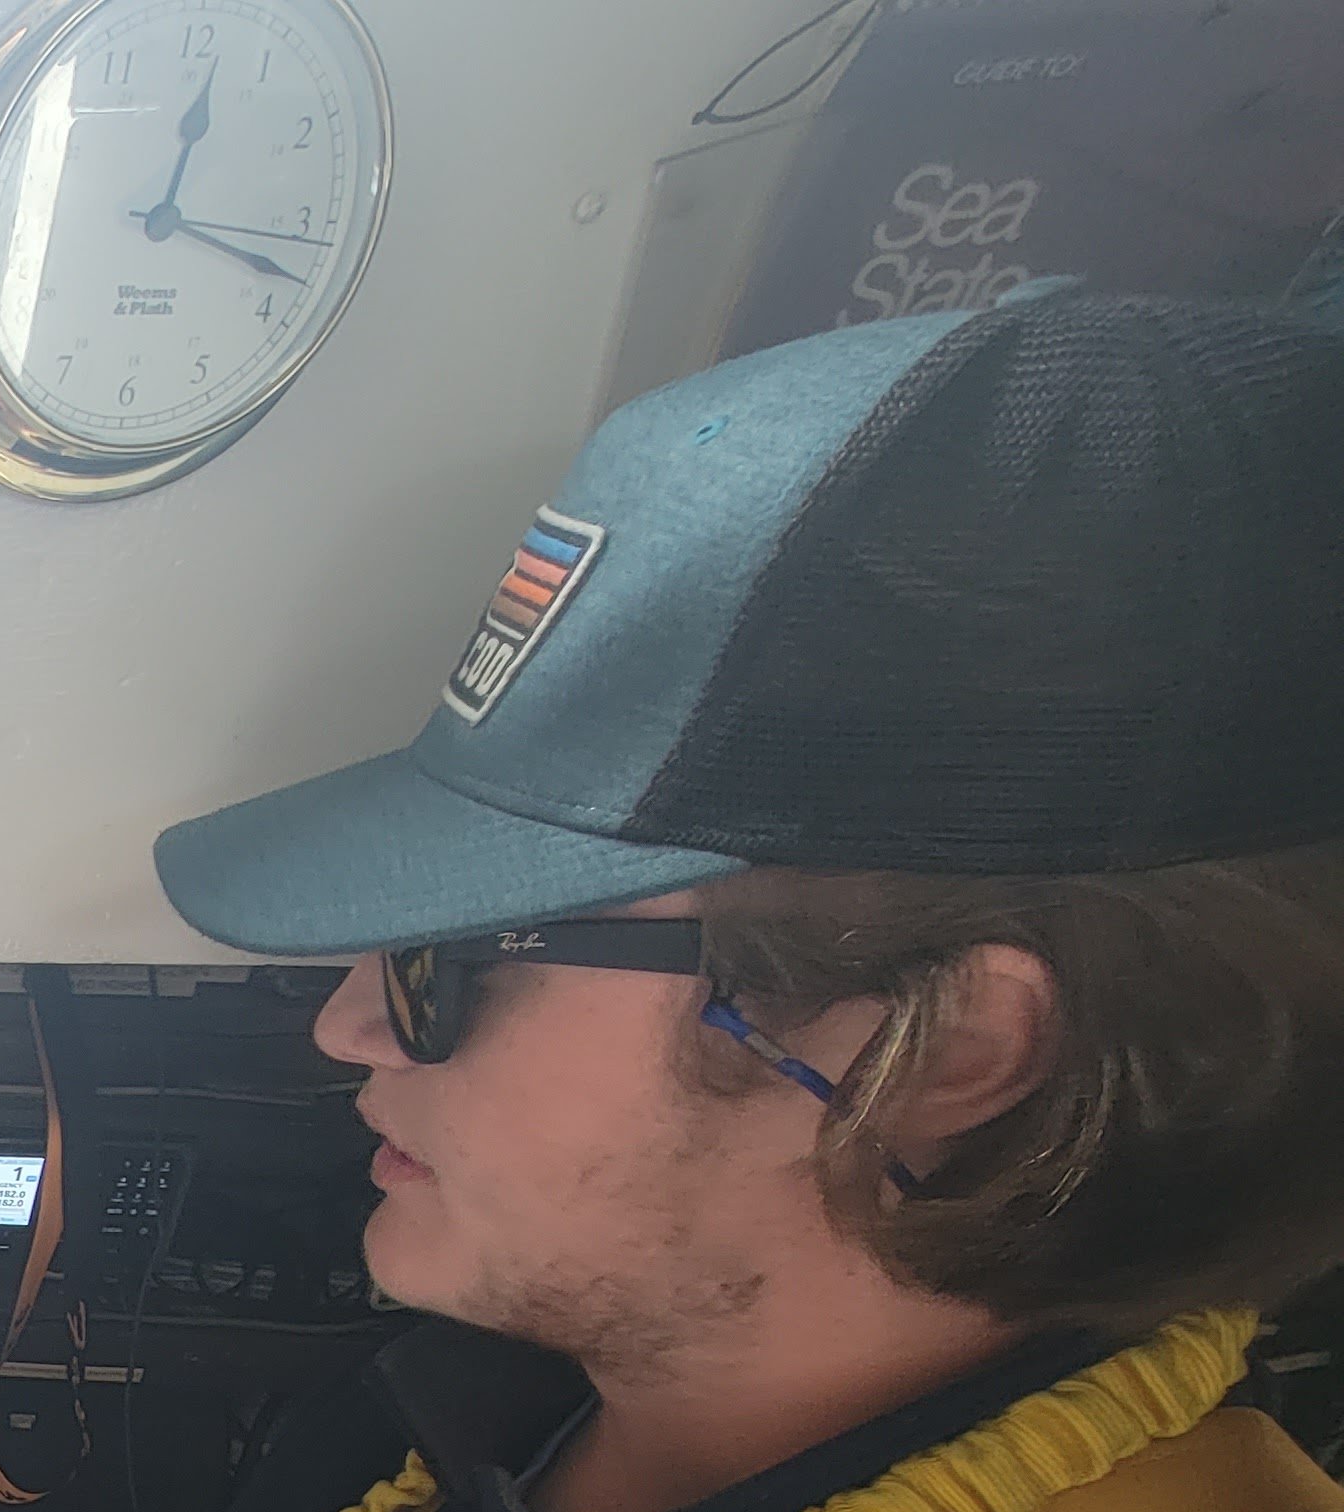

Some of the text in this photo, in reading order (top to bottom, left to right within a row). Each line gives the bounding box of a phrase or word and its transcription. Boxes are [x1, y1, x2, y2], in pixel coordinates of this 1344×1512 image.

[180, 24, 216, 59] 12
[104, 51, 135, 85] 11
[257, 49, 272, 84] 1
[292, 117, 314, 150] 2
[295, 206, 313, 238] 3
[873, 163, 1039, 249] Sea
[118, 285, 178, 301] Weems
[254, 293, 275, 324] 4
[129, 302, 175, 317] Plath
[55, 355, 75, 386] 7
[188, 354, 212, 386] 5
[119, 376, 138, 408] 6
[13, 1166, 24, 1181] 1
